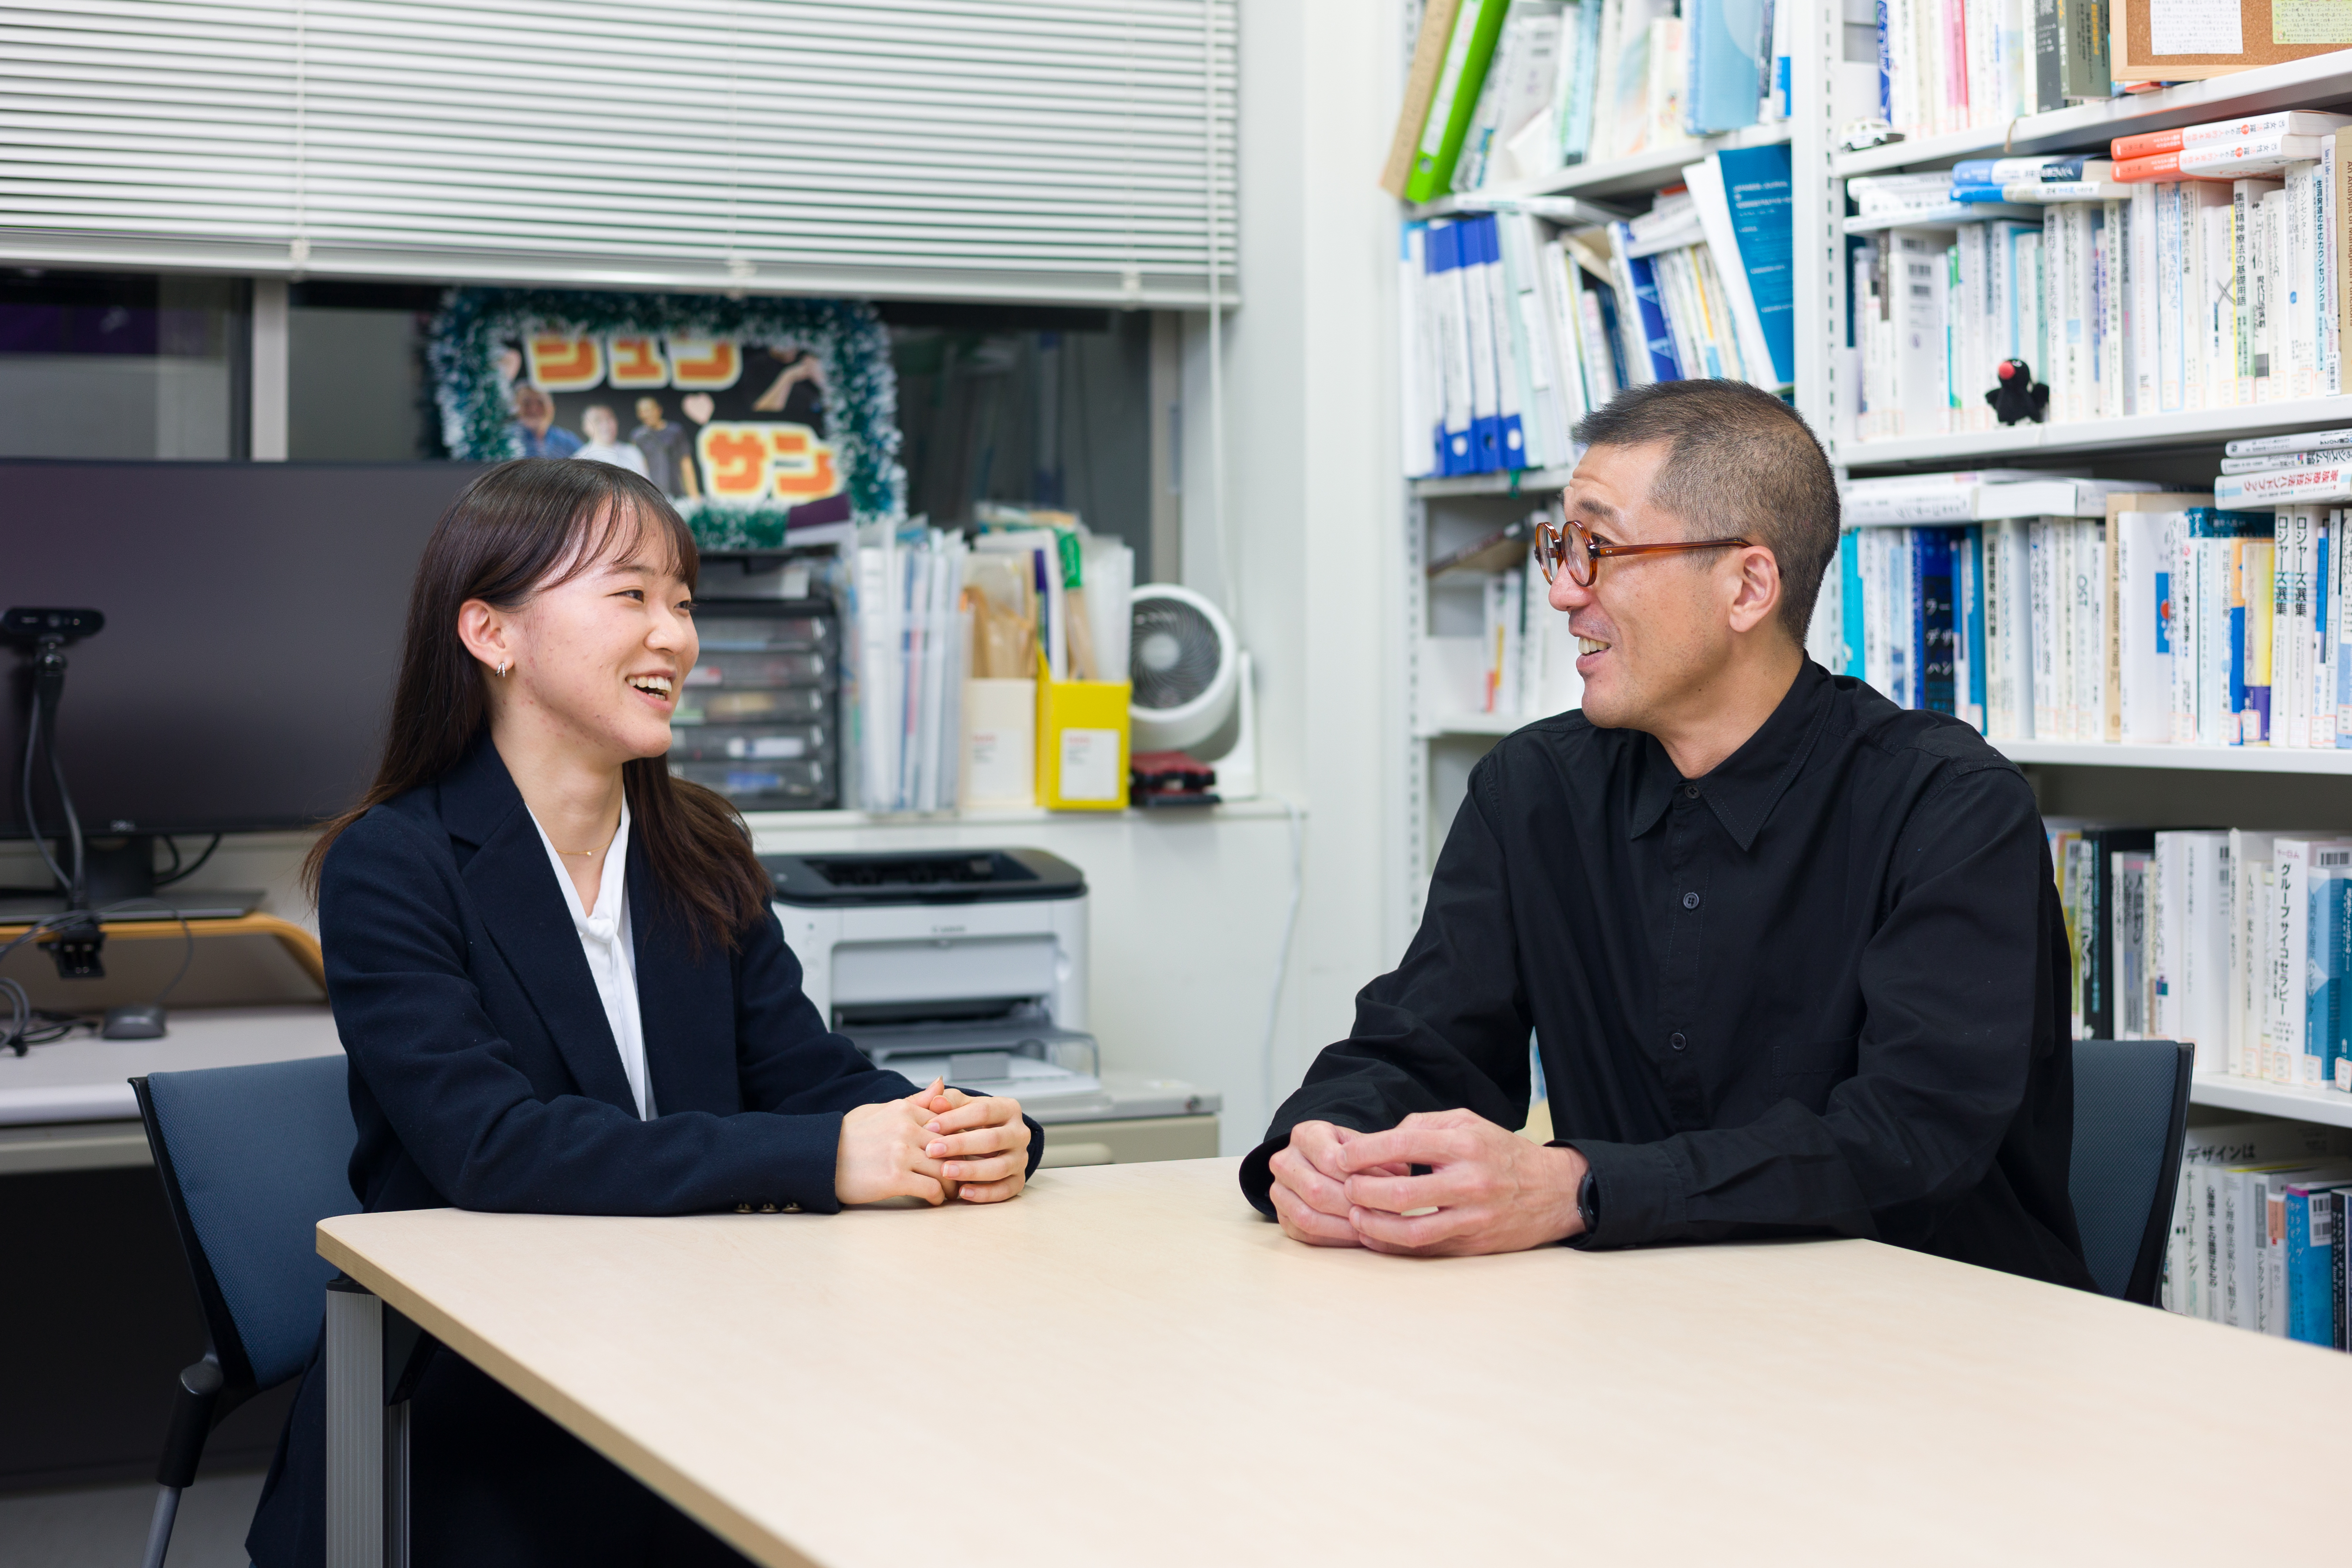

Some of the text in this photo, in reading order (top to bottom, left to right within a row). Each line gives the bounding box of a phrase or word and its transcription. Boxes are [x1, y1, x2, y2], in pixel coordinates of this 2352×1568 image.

[2076, 574, 2088, 608] OST
[2276, 516, 2289, 616] ロジャーズ選集
[2295, 517, 2308, 617] ロジャーズ選集
[2279, 863, 2291, 1017] グループサイコセラピー
[2186, 1142, 2256, 1164] デザインは
